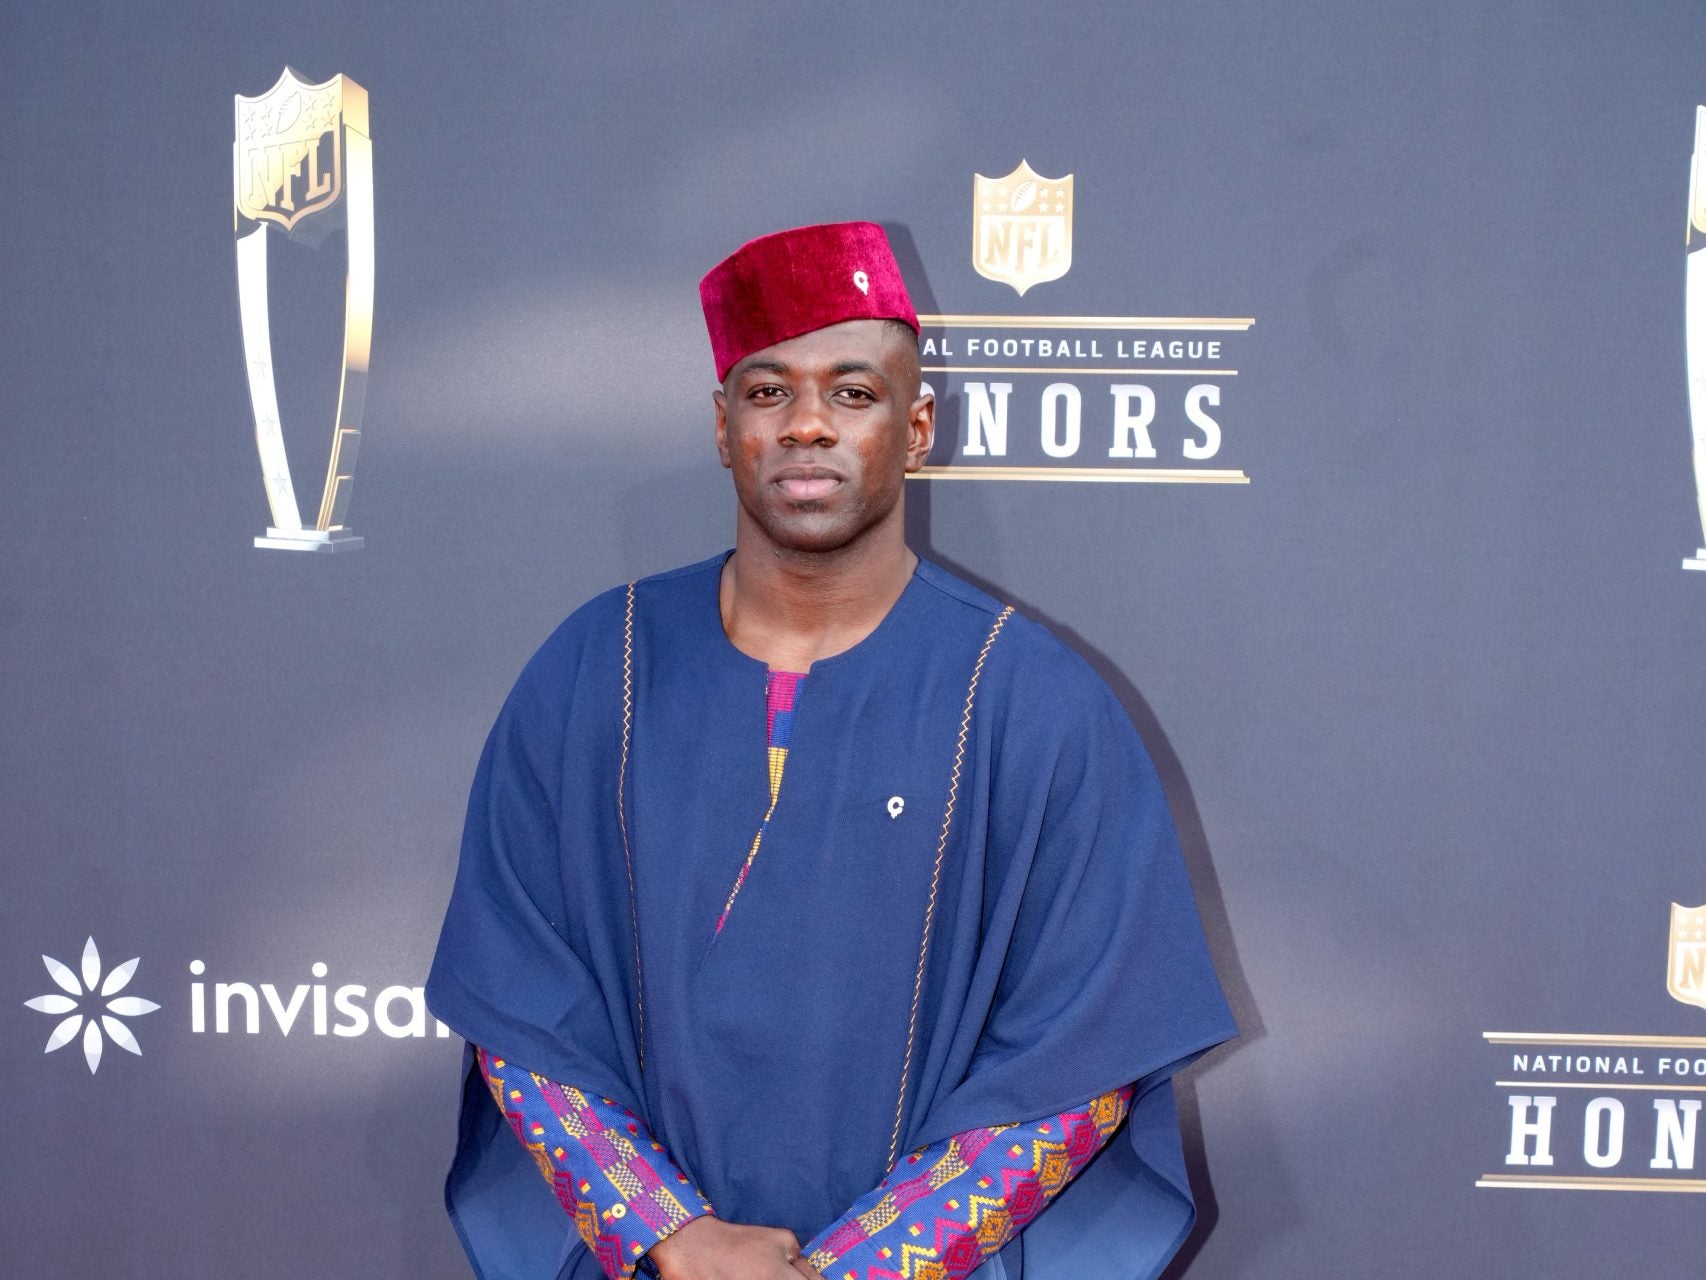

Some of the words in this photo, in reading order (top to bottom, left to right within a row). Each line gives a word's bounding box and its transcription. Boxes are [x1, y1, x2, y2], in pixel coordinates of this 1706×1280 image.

[985, 220, 1060, 273] NFL
[966, 338, 1104, 358] FOOTBALL
[1117, 340, 1222, 359] LEAGUE
[920, 381, 1222, 460] NORS
[1512, 1054, 1645, 1075] NATIONAL
